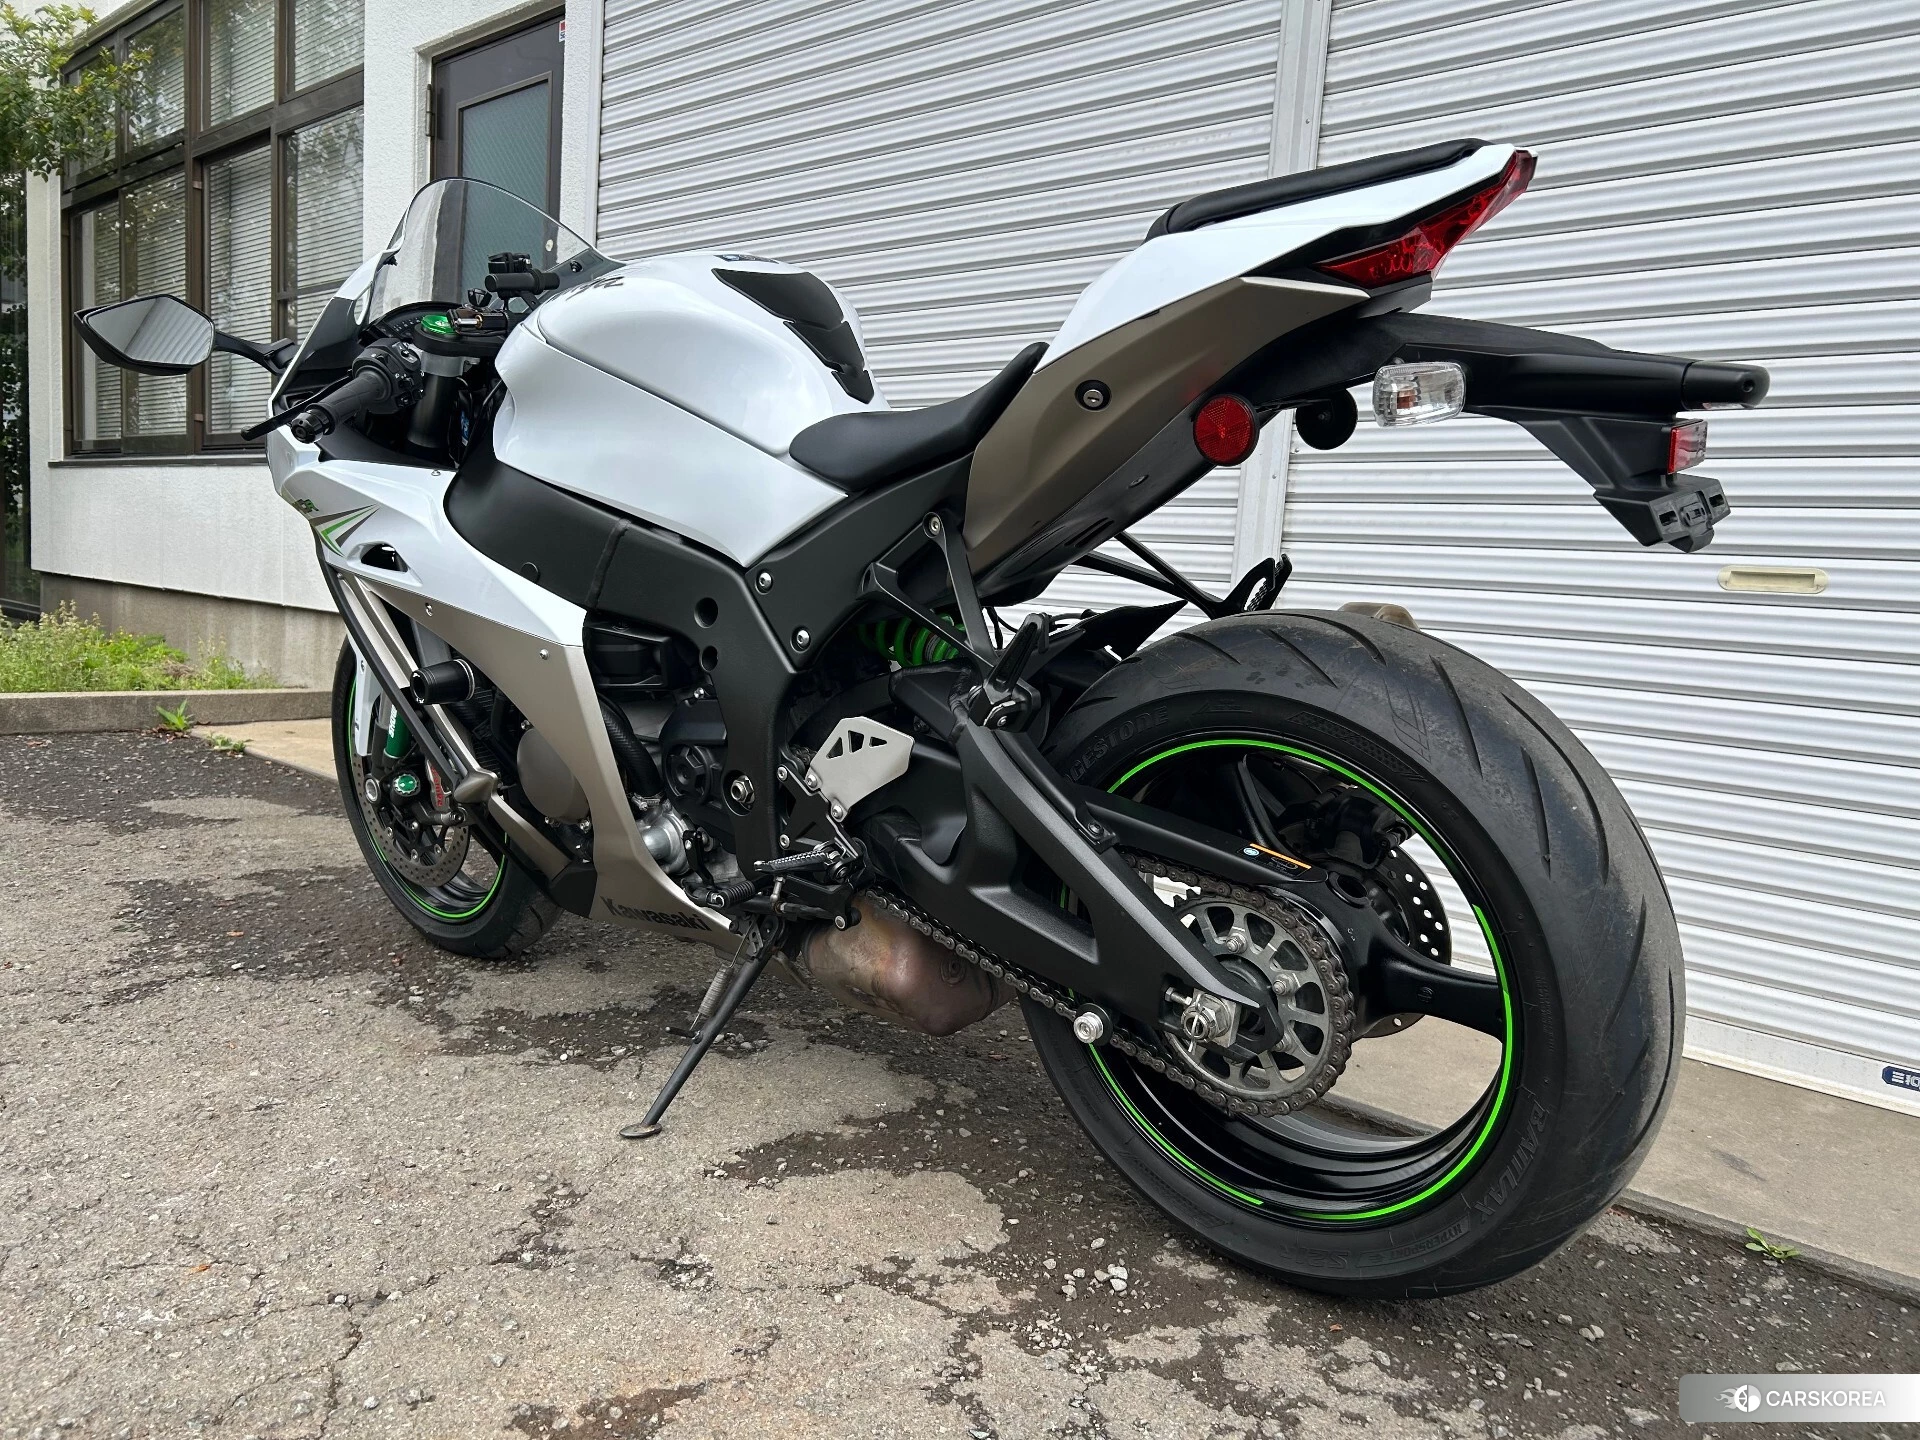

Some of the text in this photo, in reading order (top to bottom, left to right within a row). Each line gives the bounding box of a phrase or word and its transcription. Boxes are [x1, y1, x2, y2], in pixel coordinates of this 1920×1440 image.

[388, 704, 398, 738] SHOW
[1064, 704, 1168, 782] GESTONE
[600, 895, 713, 932] Kawasaki
[1473, 1100, 1550, 1225] BATTLAX
